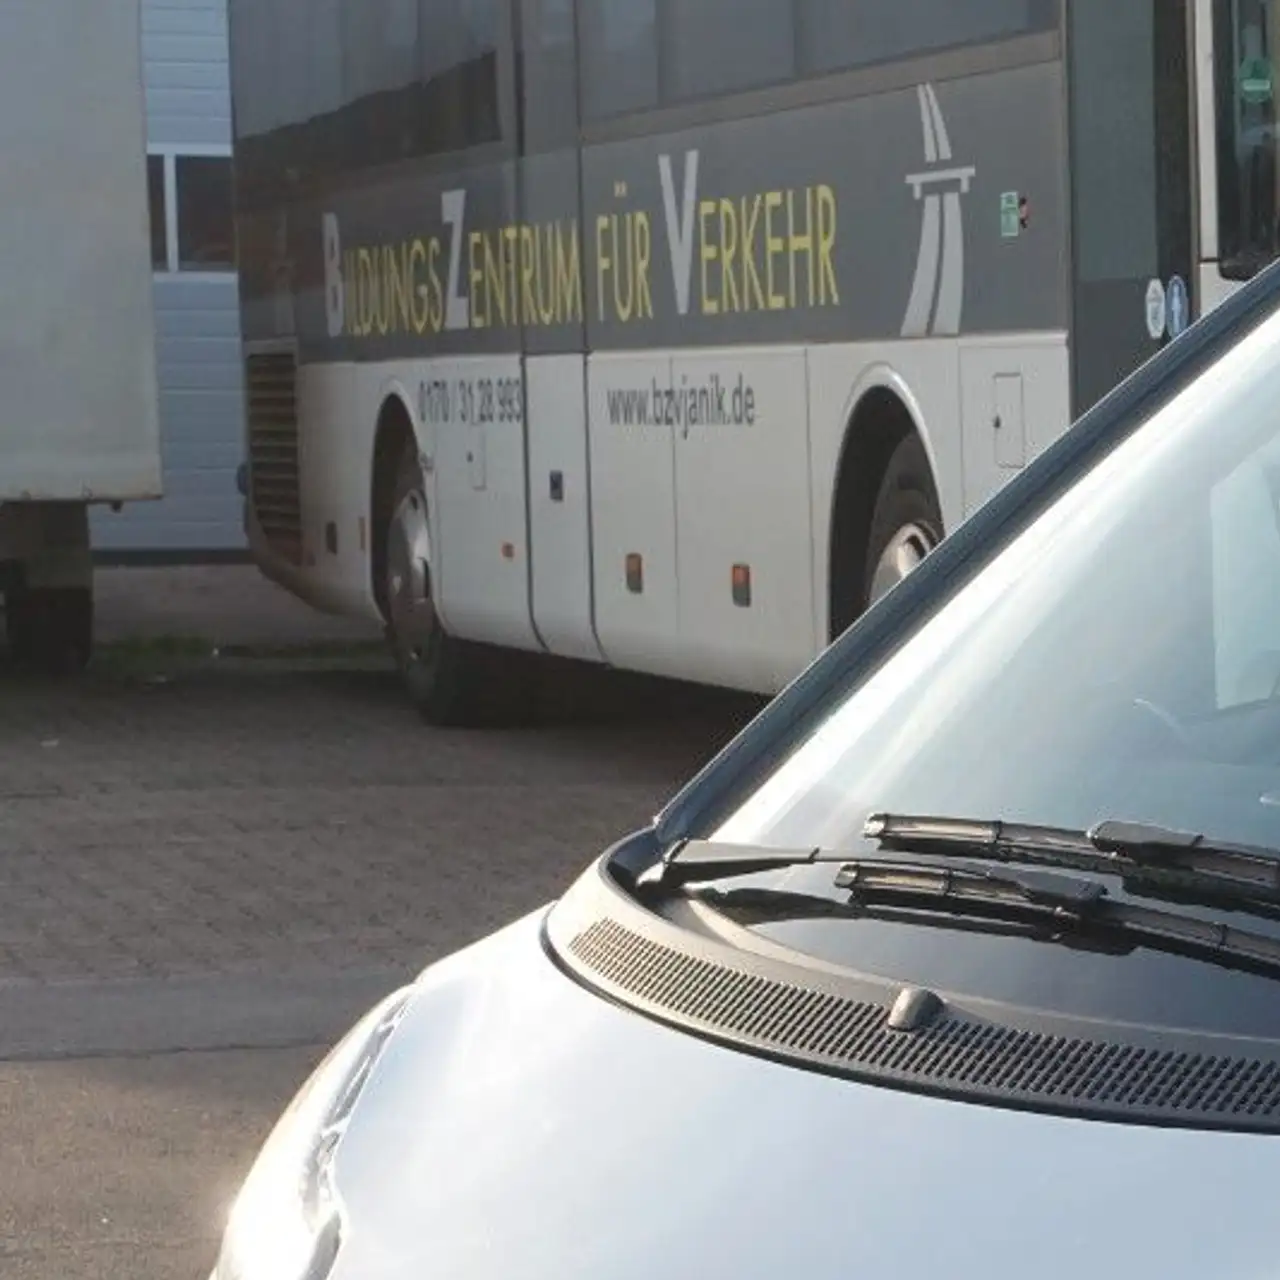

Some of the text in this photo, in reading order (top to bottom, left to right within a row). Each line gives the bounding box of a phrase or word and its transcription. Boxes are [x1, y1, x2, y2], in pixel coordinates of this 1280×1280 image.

[596, 180, 654, 322] FÜR
[658, 149, 840, 316] VERKEHR
[606, 372, 756, 440] www.bzvjanik.de
